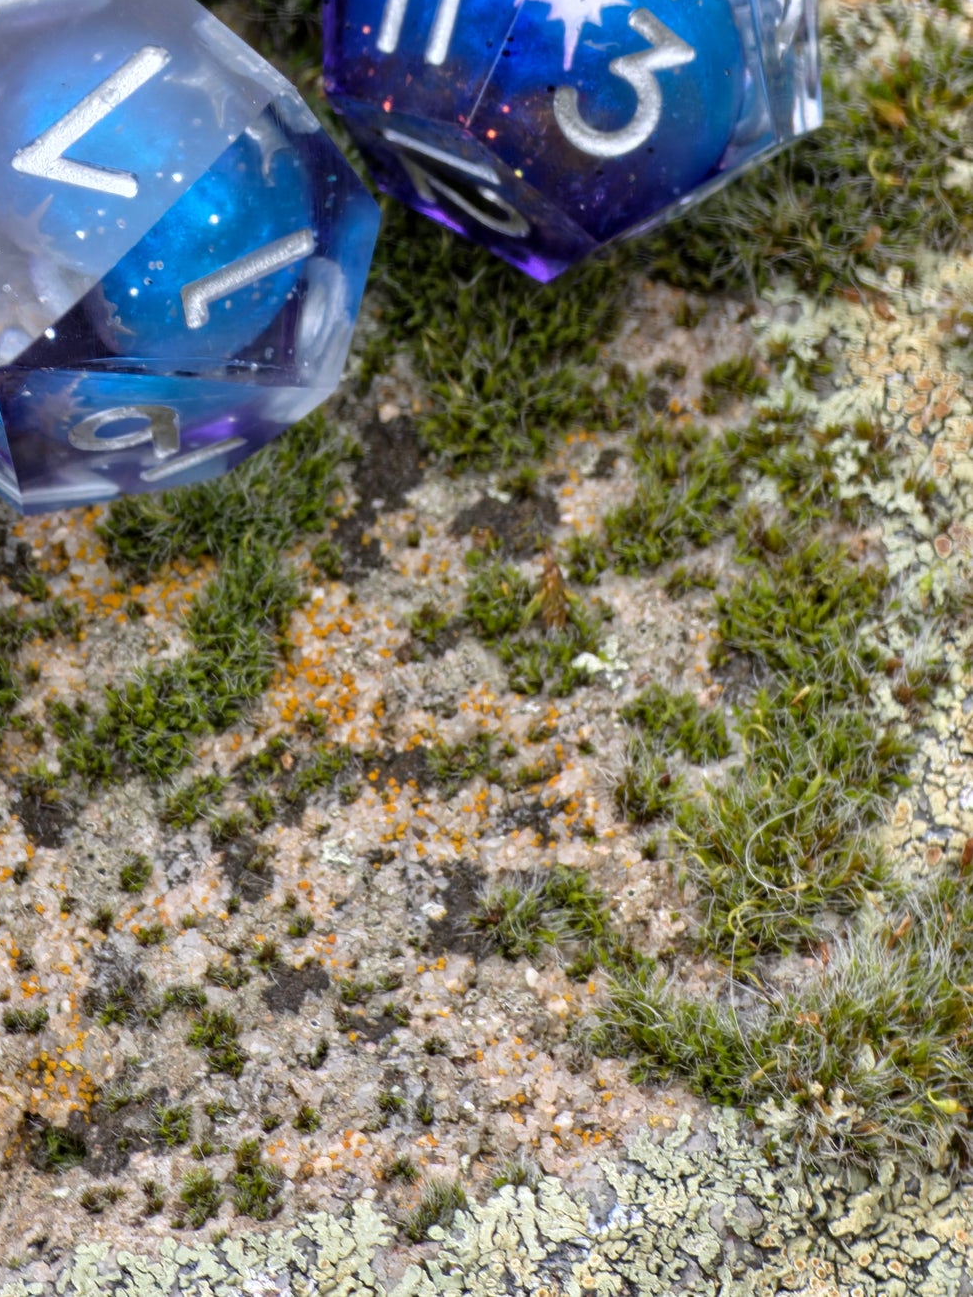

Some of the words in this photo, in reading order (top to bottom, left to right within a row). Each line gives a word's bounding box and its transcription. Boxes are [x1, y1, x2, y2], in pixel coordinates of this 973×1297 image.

[11, 44, 172, 199] 7
[553, 7, 696, 158] 3
[180, 227, 315, 330] 1
